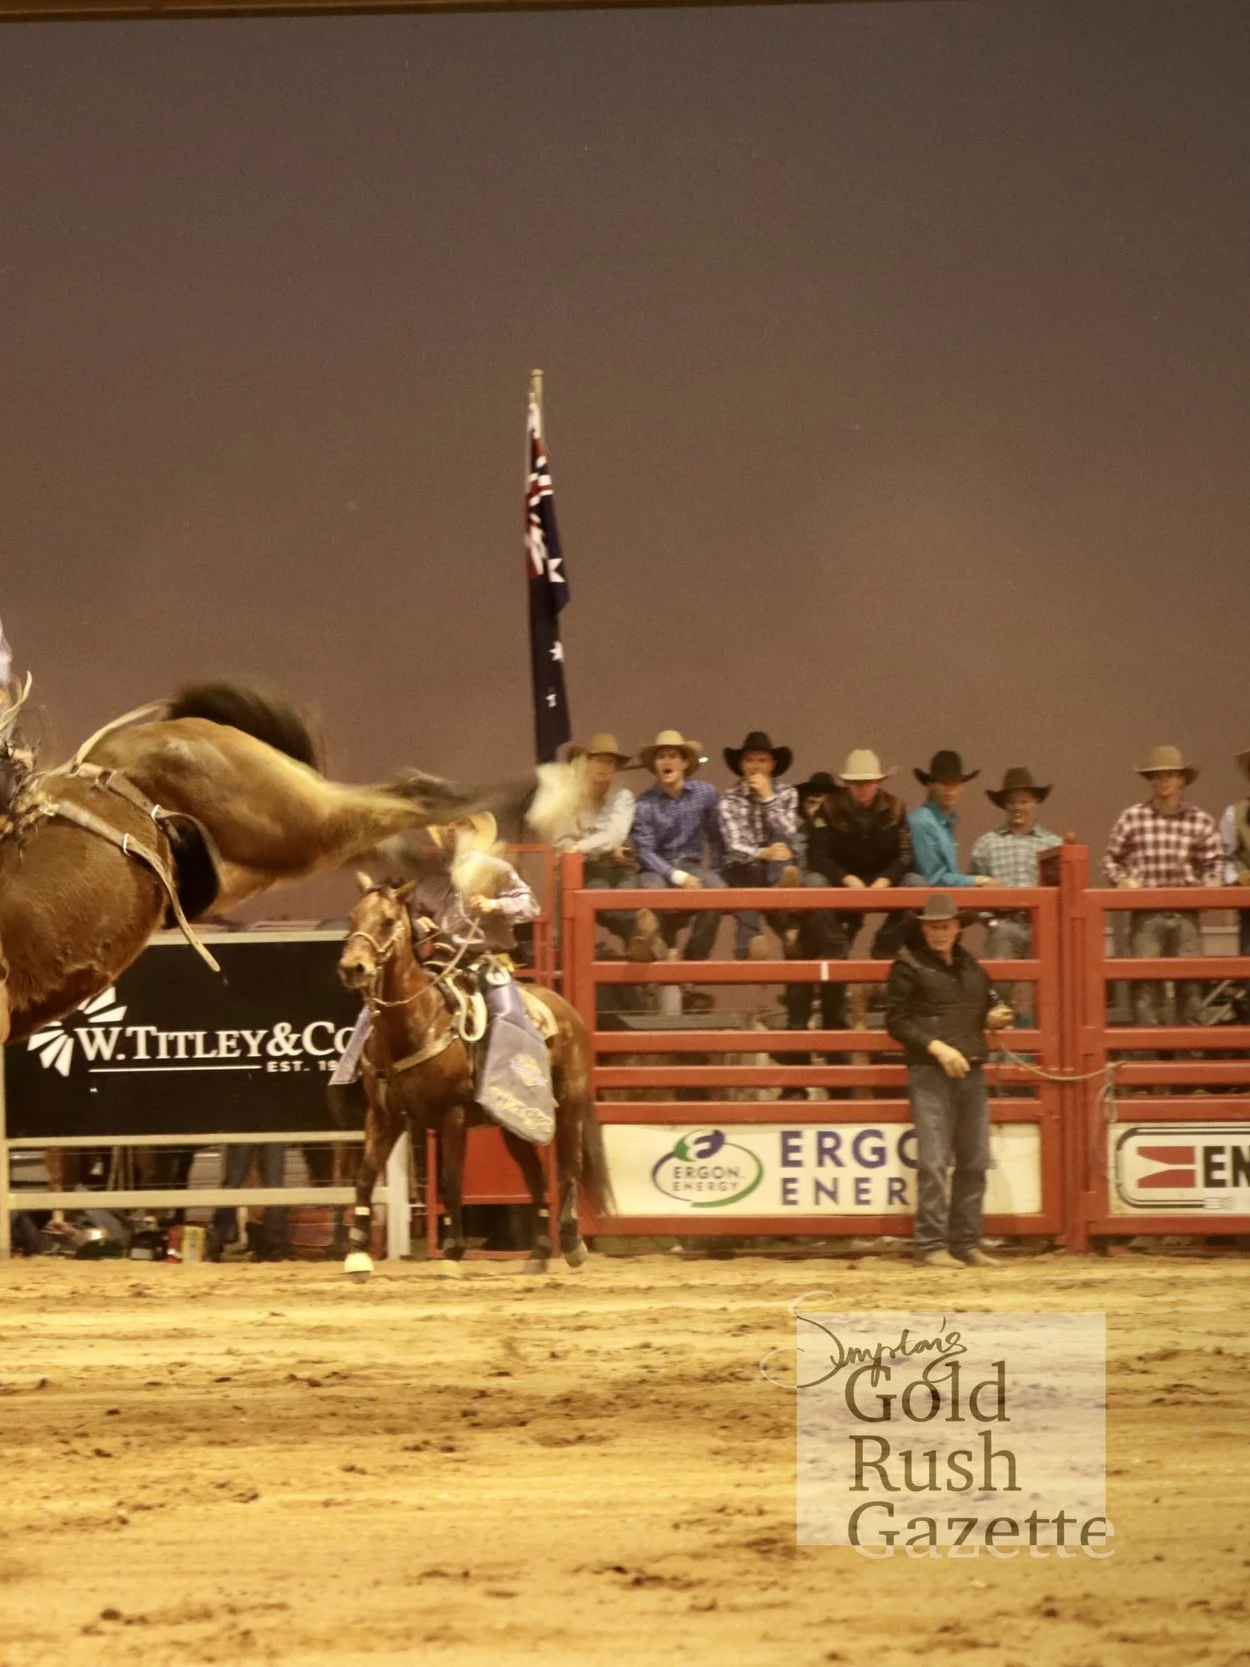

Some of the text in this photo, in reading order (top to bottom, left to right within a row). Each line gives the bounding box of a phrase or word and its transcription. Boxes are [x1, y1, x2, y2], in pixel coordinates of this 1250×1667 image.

[266, 1060, 310, 1073] EST.
[780, 1128, 918, 1169] ERGO
[673, 1166, 740, 1179] ERGON
[672, 1181, 739, 1192] ENERGY
[781, 1176, 910, 1206] ENER
